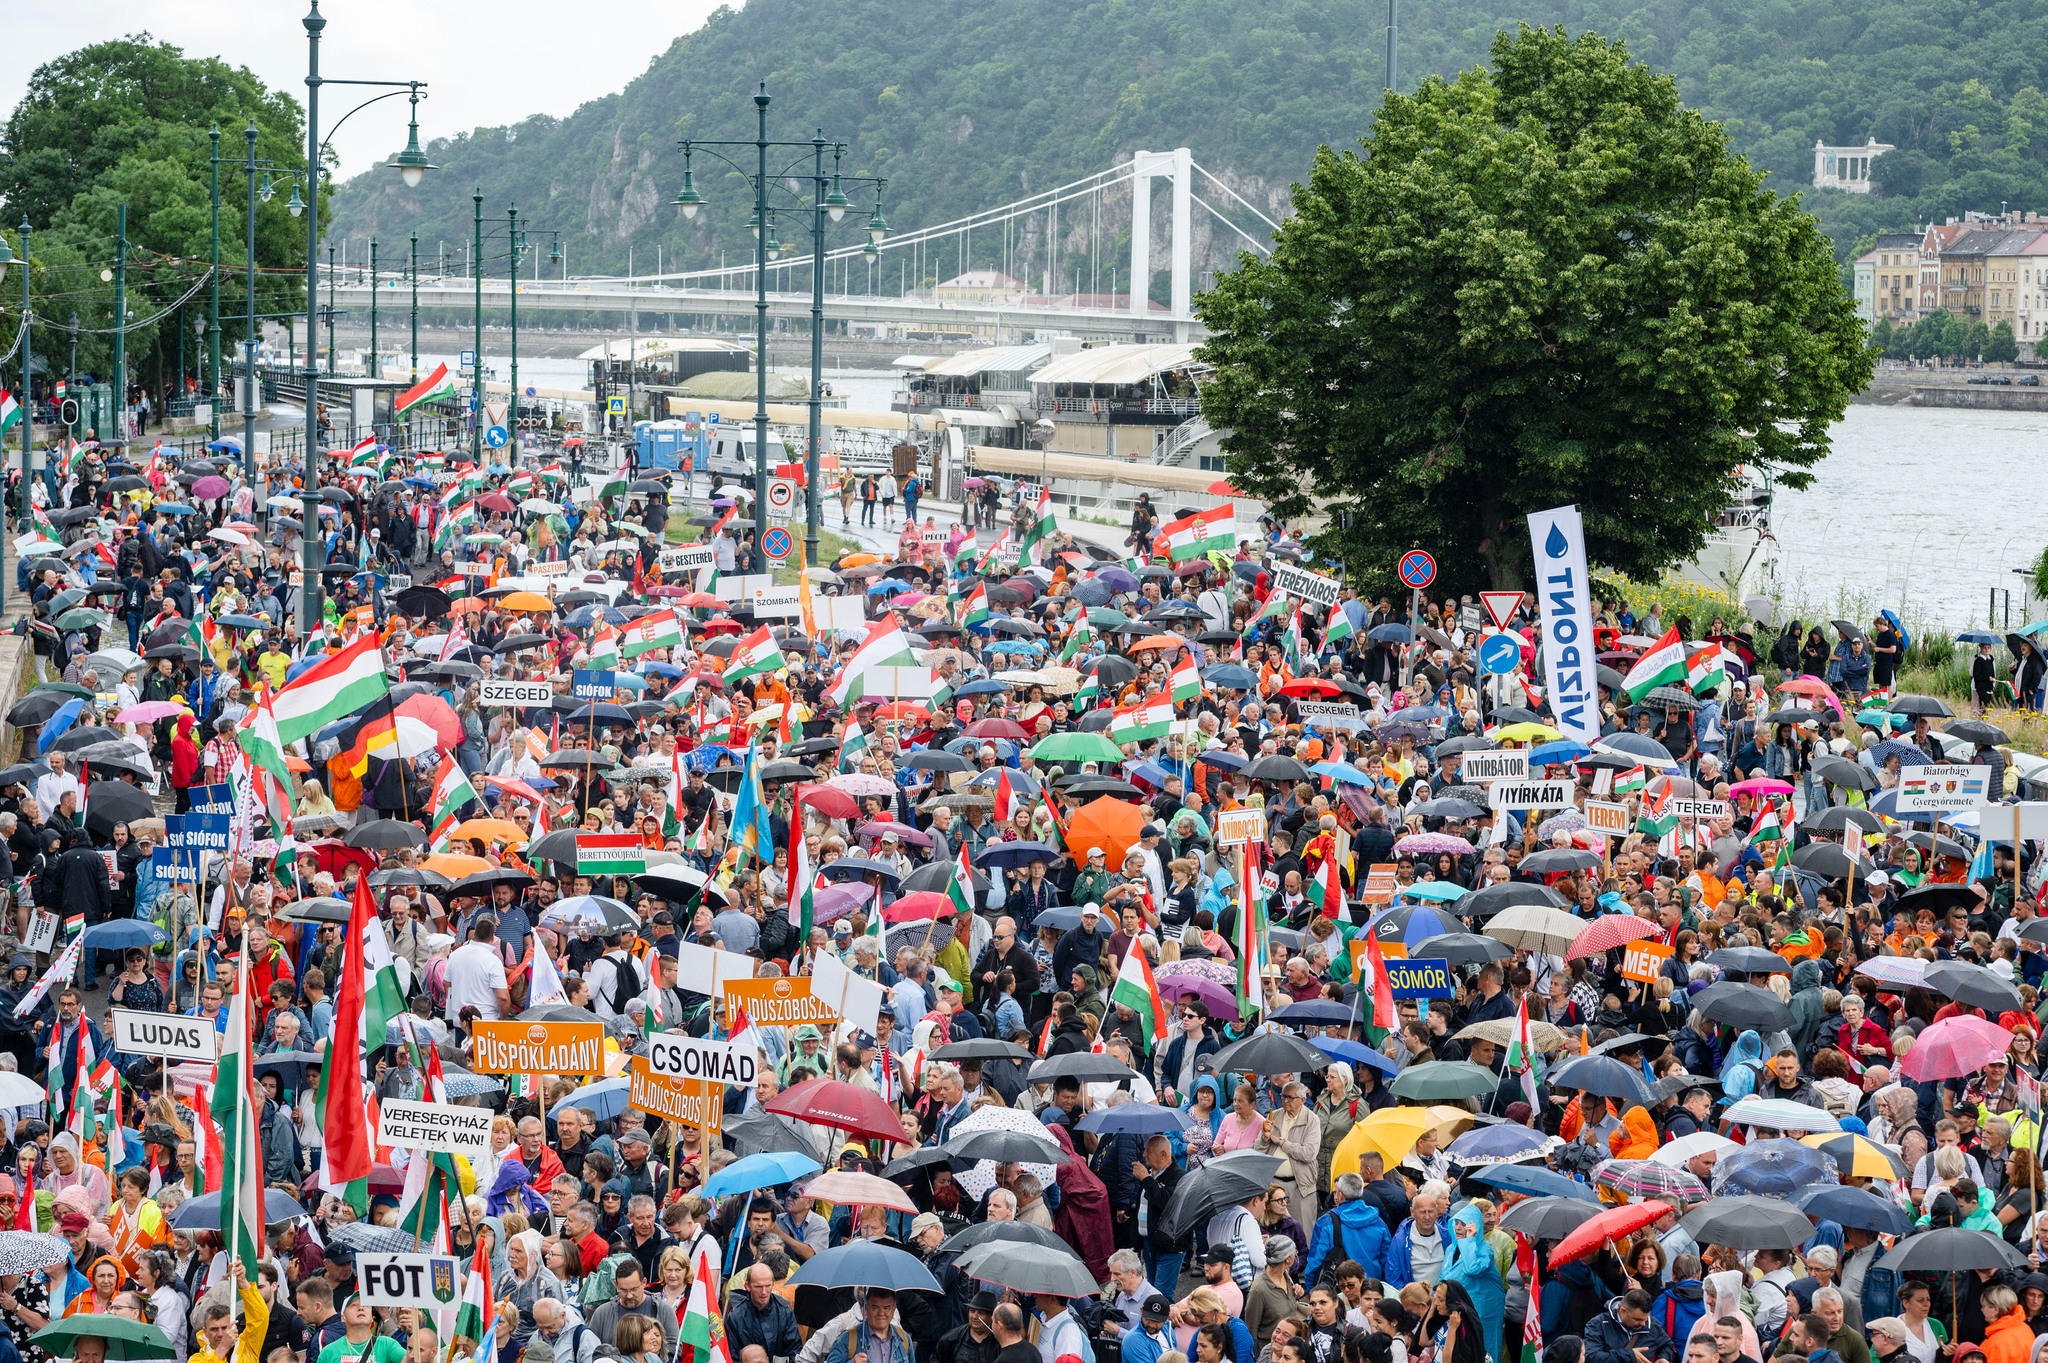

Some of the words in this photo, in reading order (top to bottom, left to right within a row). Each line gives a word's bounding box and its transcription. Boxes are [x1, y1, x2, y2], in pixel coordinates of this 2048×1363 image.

[925, 532, 948, 540] PÉCEL
[676, 552, 713, 566] GESZTERÉD
[467, 565, 481, 573] TÉT
[1278, 569, 1338, 604] TERÉZVÁROS
[484, 687, 549, 700] SZEGED
[576, 684, 612, 697] SIÓFOK
[1300, 704, 1356, 716] KECSKEMÉT
[1467, 755, 1524, 777] NYÍRBÁTOR
[1923, 766, 1971, 777] Biatorbágy
[1676, 802, 1723, 814] TEREM
[1912, 797, 1974, 808] Gyergyóremete
[1587, 806, 1626, 830] TEREM
[186, 830, 226, 847] SIÓFOK
[579, 848, 643, 860] BERETTYÓÚJFALU
[156, 864, 197, 880] SIÓFOK
[1388, 965, 1447, 989] SÖMÖR
[130, 1023, 200, 1049] LUDAS
[476, 1031, 599, 1071] PÜSPÖKLADÁNY
[652, 1044, 755, 1083] CSOMÁD
[632, 1070, 720, 1129] HAJDÚSZOBOSLÓ
[384, 1108, 489, 1130] VERESEGYHÁZ
[816, 1109, 858, 1122] DUNLOP
[384, 1124, 448, 1142] VELETEK
[453, 1132, 484, 1146] VAN!
[364, 1256, 424, 1298] FÓT
